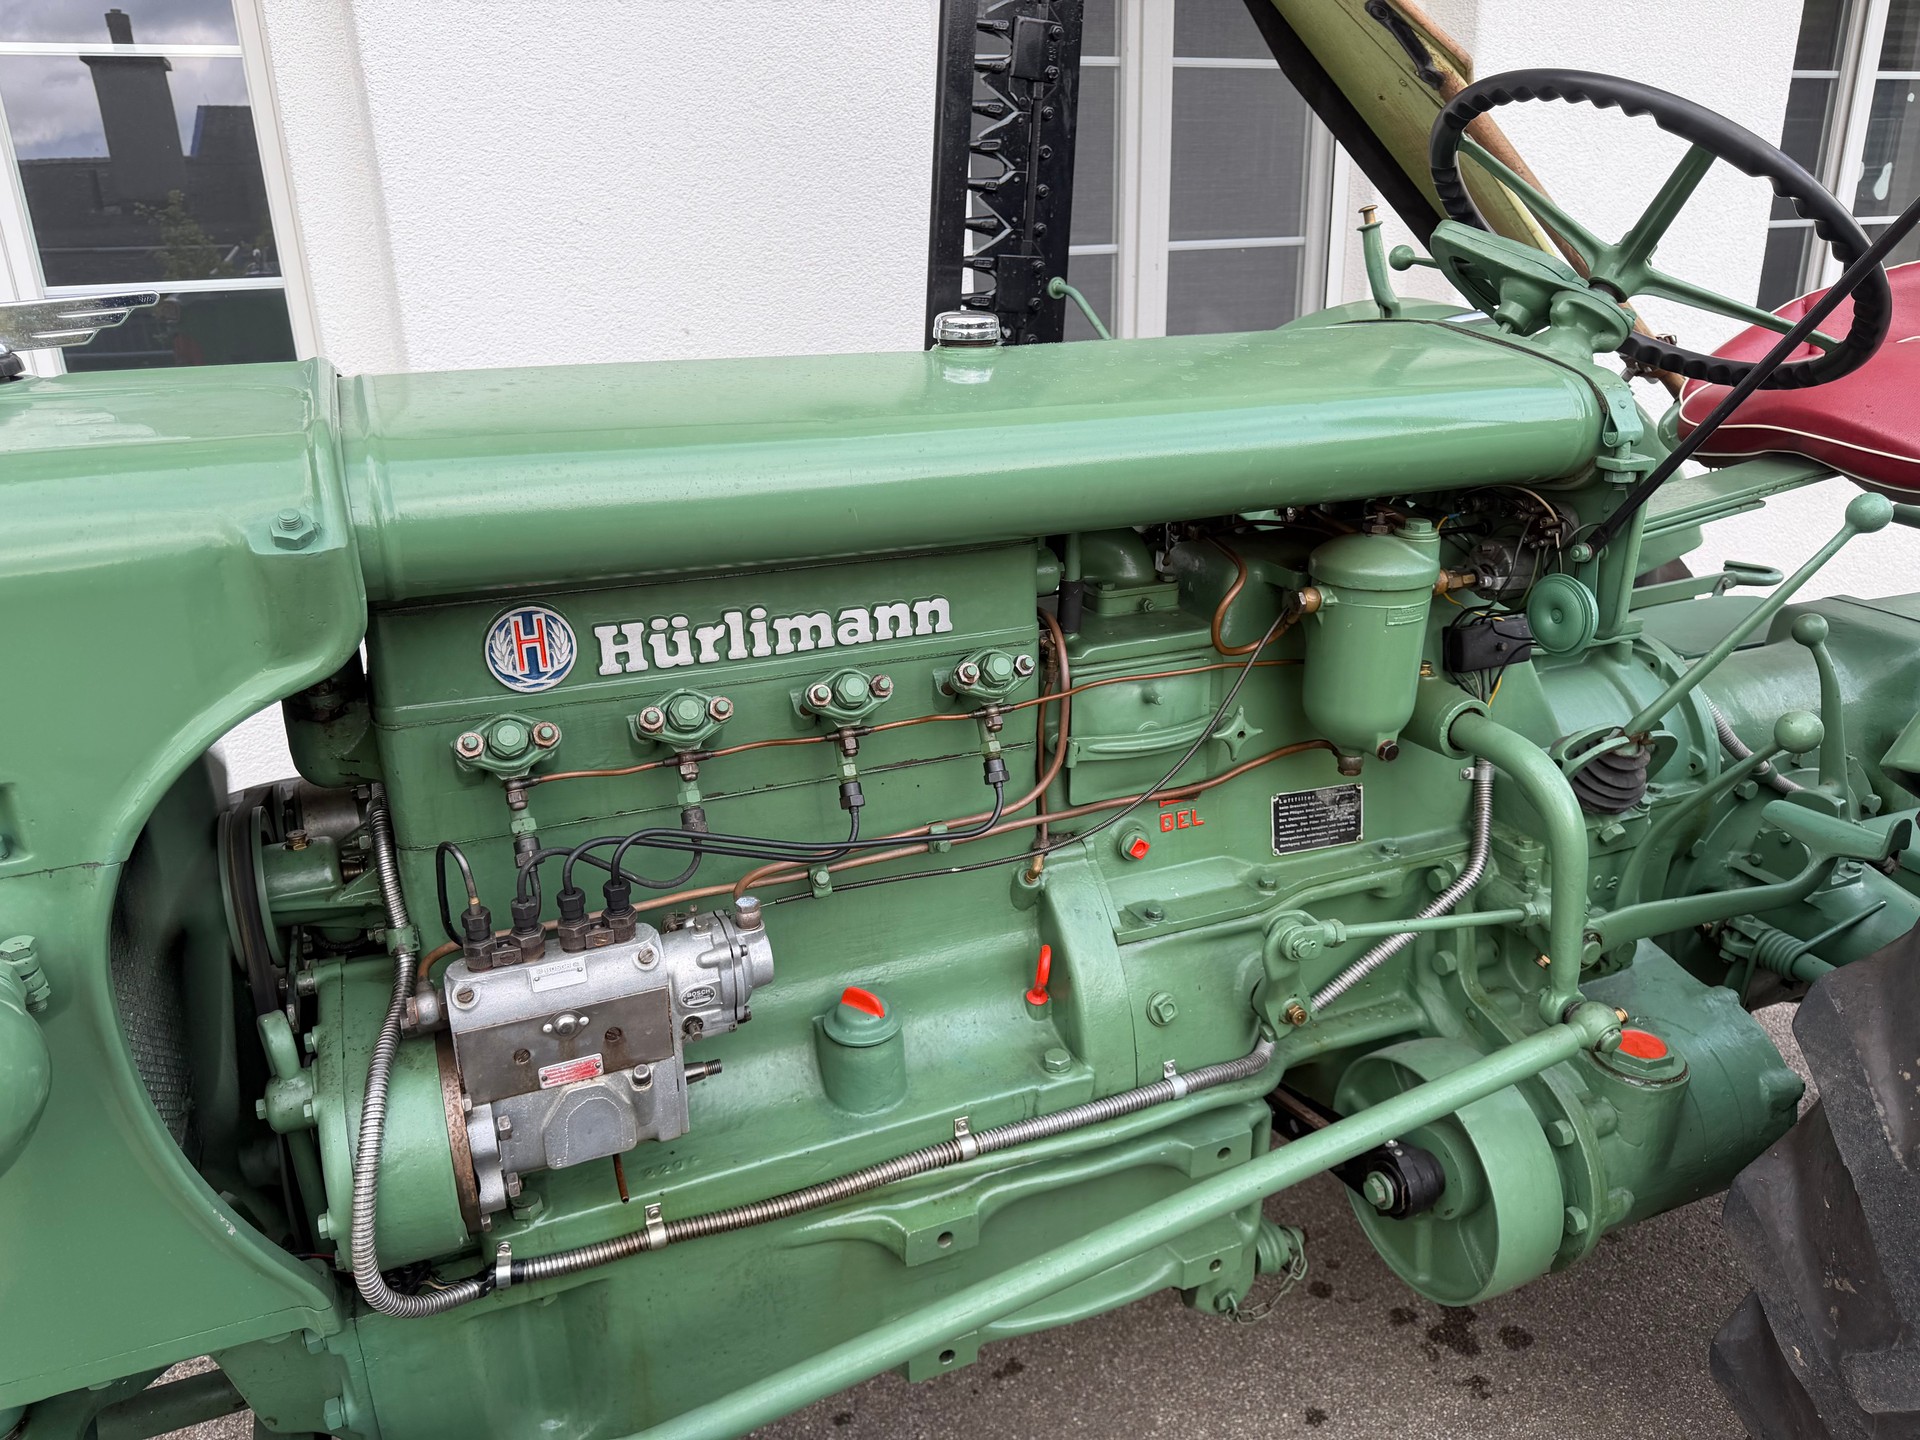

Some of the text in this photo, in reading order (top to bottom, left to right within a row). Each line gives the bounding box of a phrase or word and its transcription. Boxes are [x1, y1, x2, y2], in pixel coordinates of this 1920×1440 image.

[594, 597, 953, 675] Hürlimann
[1160, 809, 1205, 832] OEL
[687, 988, 711, 998] BOSCH
